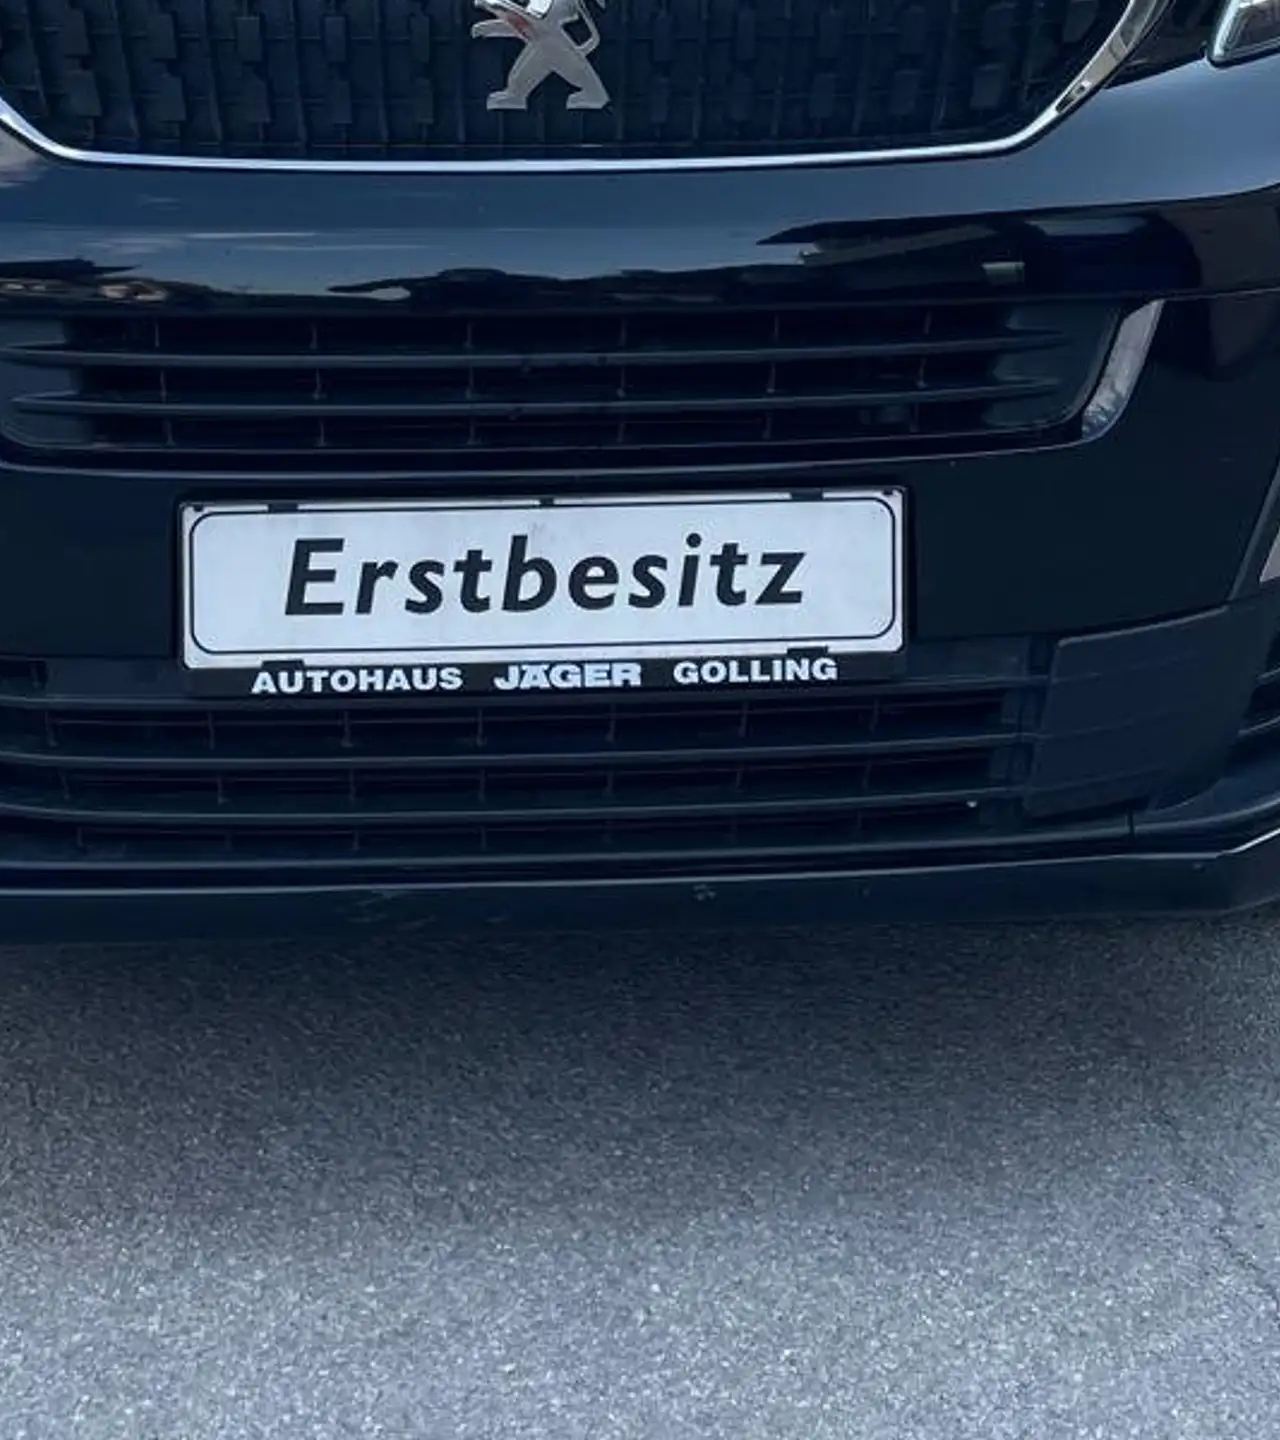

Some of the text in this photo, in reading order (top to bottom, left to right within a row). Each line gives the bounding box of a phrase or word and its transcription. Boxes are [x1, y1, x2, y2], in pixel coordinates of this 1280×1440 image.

[283, 532, 807, 617] Erstbesitz
[251, 657, 839, 694] AUTOHAUS JÄGER GOLLING
